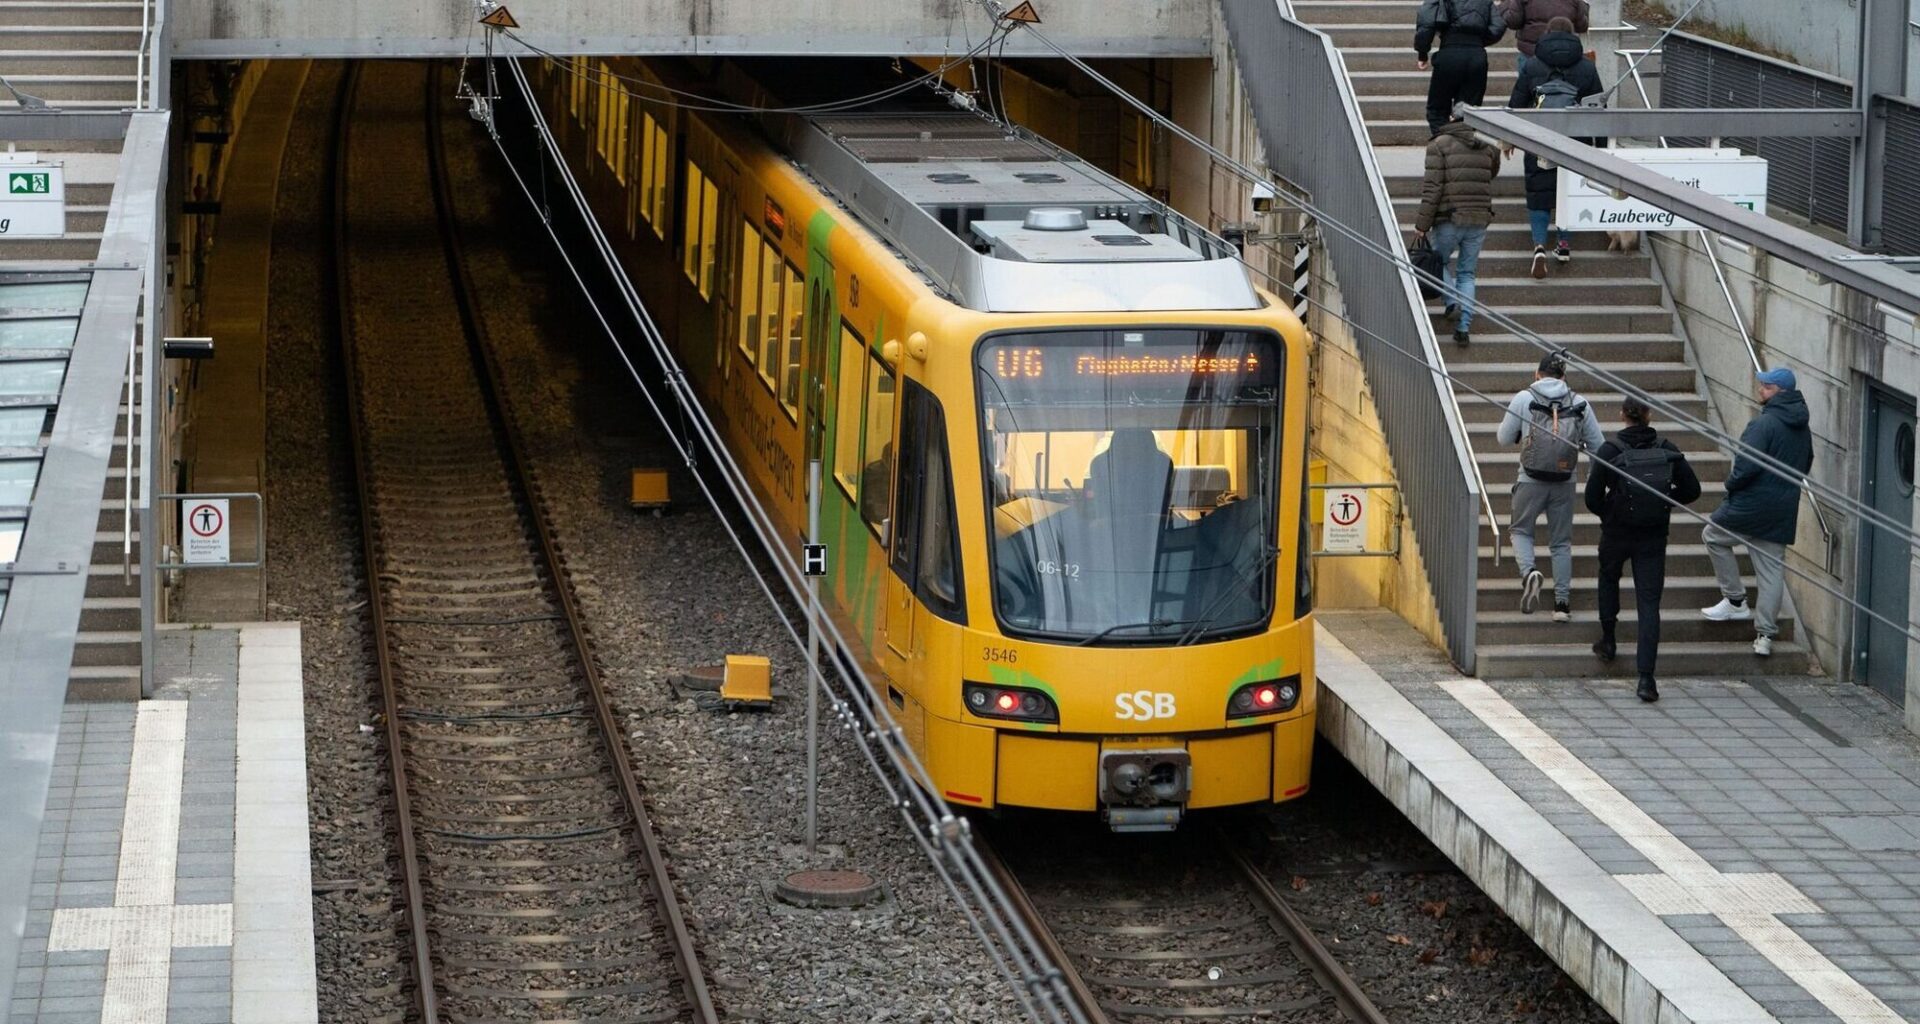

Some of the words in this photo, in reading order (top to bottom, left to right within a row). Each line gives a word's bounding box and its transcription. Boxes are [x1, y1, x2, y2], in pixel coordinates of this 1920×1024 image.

[1599, 209, 1675, 227] Laubeweg
[998, 349, 1043, 378] U6
[805, 548, 826, 573] H
[1037, 560, 1080, 578] 06-12
[982, 647, 1018, 664] 3546
[1115, 690, 1176, 721] SSB
